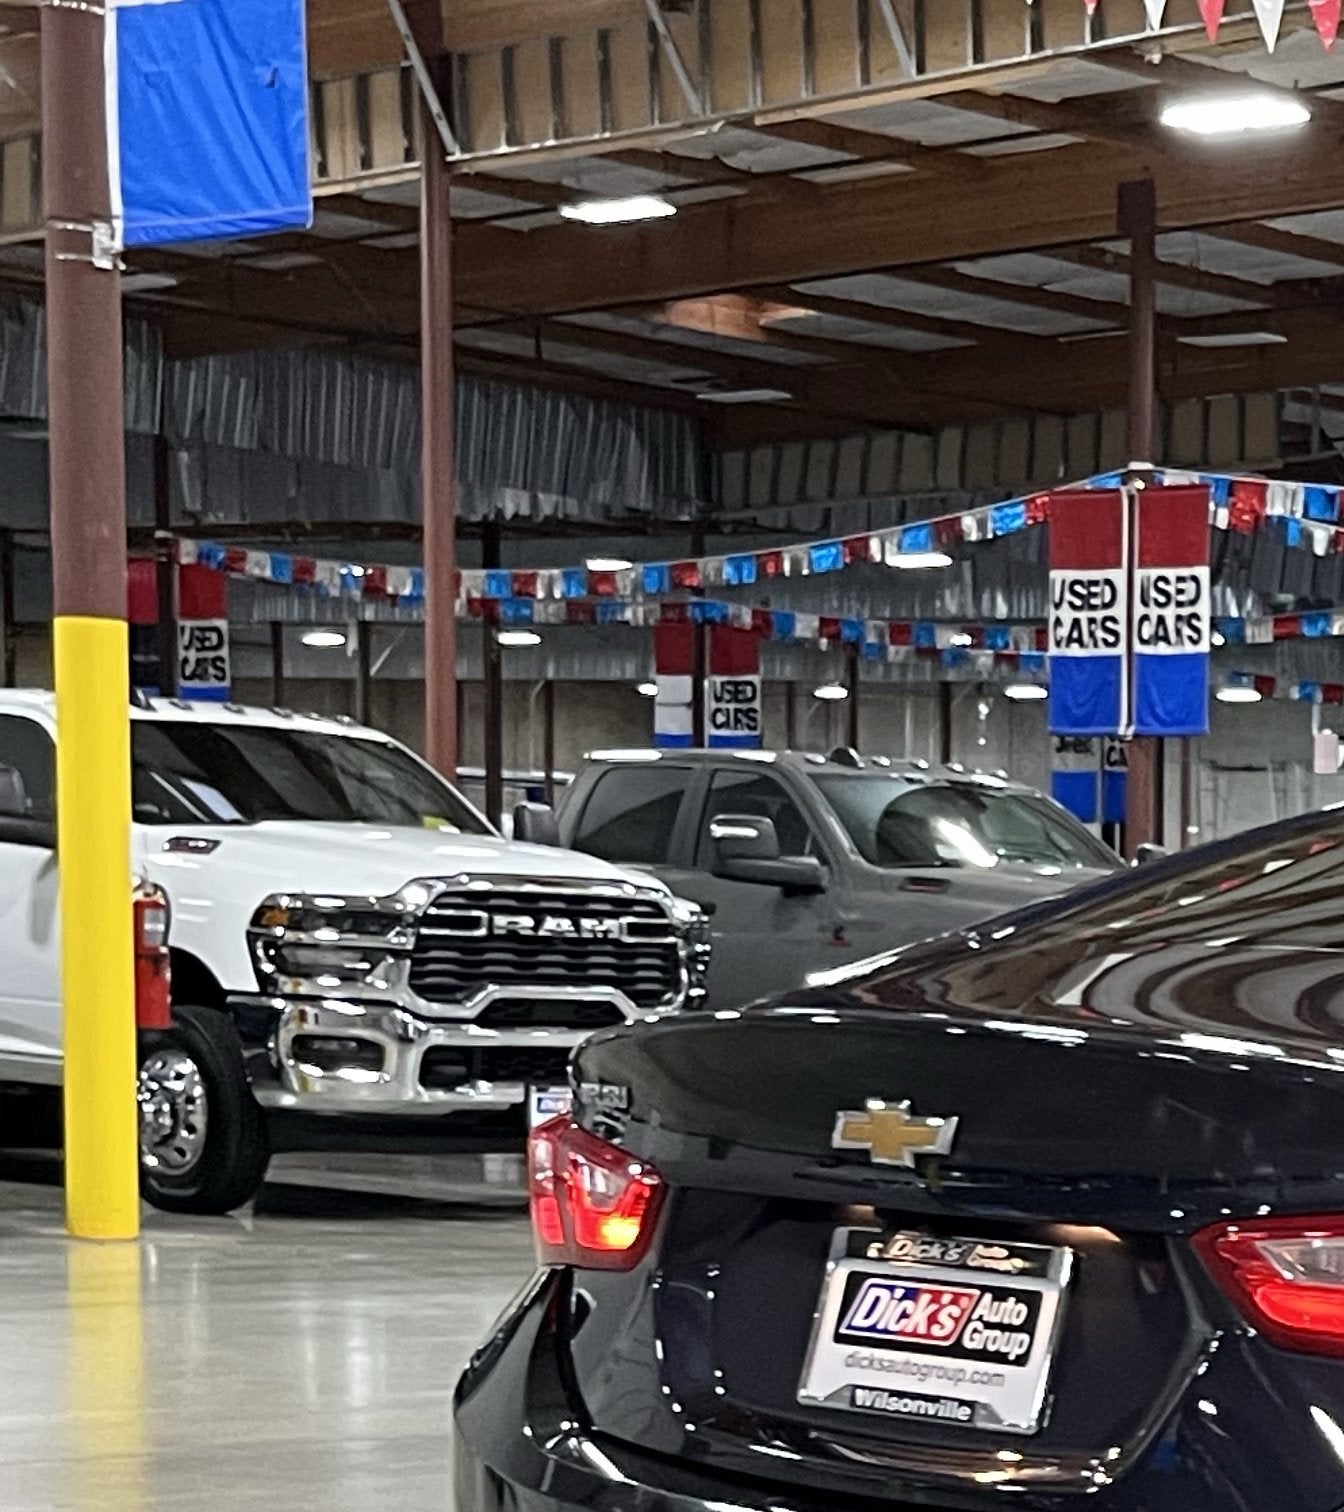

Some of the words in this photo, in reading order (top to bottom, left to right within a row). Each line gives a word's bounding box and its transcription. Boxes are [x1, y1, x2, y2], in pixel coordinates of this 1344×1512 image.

[1051, 578, 1117, 611] USED
[1141, 574, 1200, 608] USED
[1053, 615, 1120, 649] CARS
[1138, 612, 1203, 646] CARS
[492, 914, 620, 939] RAM
[851, 1286, 962, 1338] Dick's
[971, 1292, 1028, 1325] Auto
[961, 1320, 1031, 1361] Group
[844, 1351, 1006, 1388] dicksautogroup.com
[854, 1387, 973, 1421] Wilsonville
